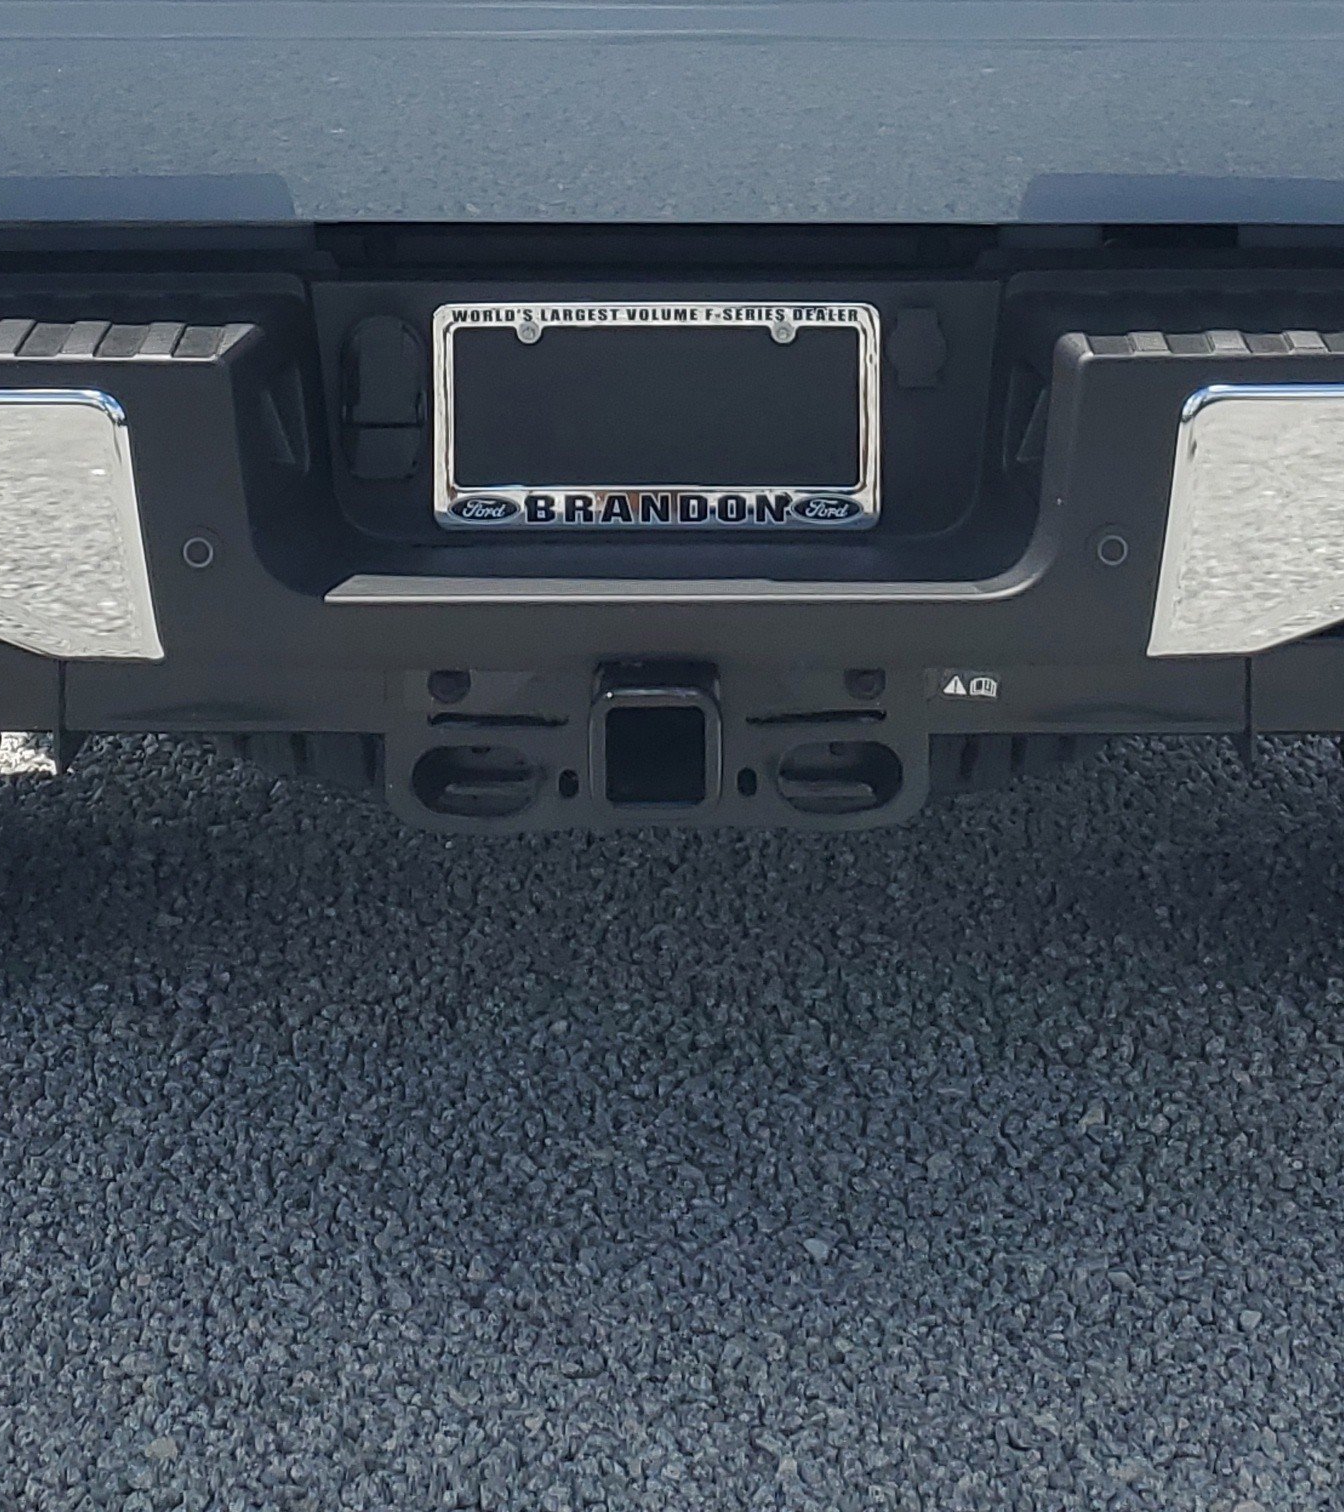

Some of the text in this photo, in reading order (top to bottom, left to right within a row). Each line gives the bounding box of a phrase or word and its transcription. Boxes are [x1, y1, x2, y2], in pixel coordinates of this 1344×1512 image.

[452, 307, 857, 322] WORLD'S LARGEST VOLUME F-SERIES DEALER
[461, 494, 849, 523] Ford BRANDON Ford
